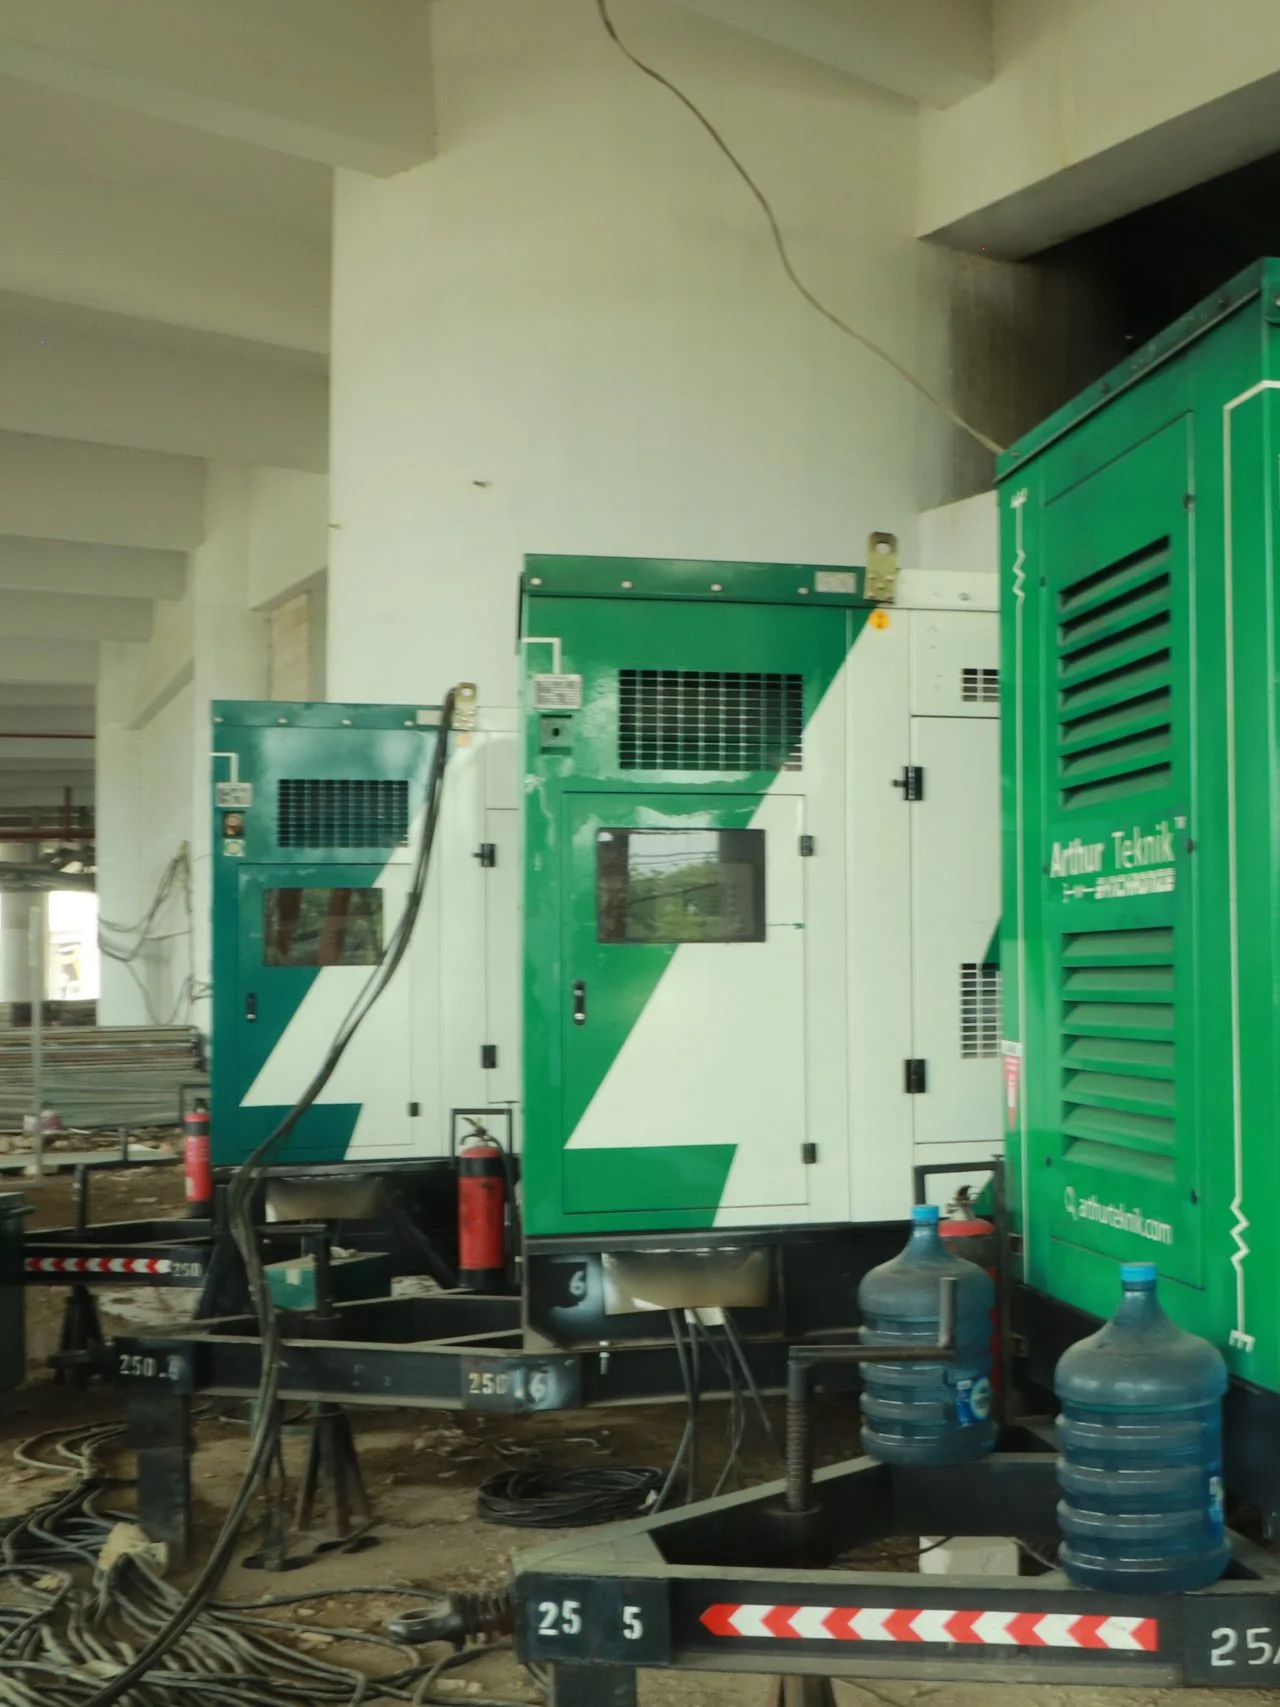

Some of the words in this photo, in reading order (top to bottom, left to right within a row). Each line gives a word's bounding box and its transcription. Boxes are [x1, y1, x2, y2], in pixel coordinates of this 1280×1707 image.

[1050, 840, 1104, 878] Arthur
[1111, 820, 1175, 869] Teknik
[569, 1270, 586, 1296] 6
[538, 1599, 582, 1636] 25
[622, 1605, 644, 1640] 5
